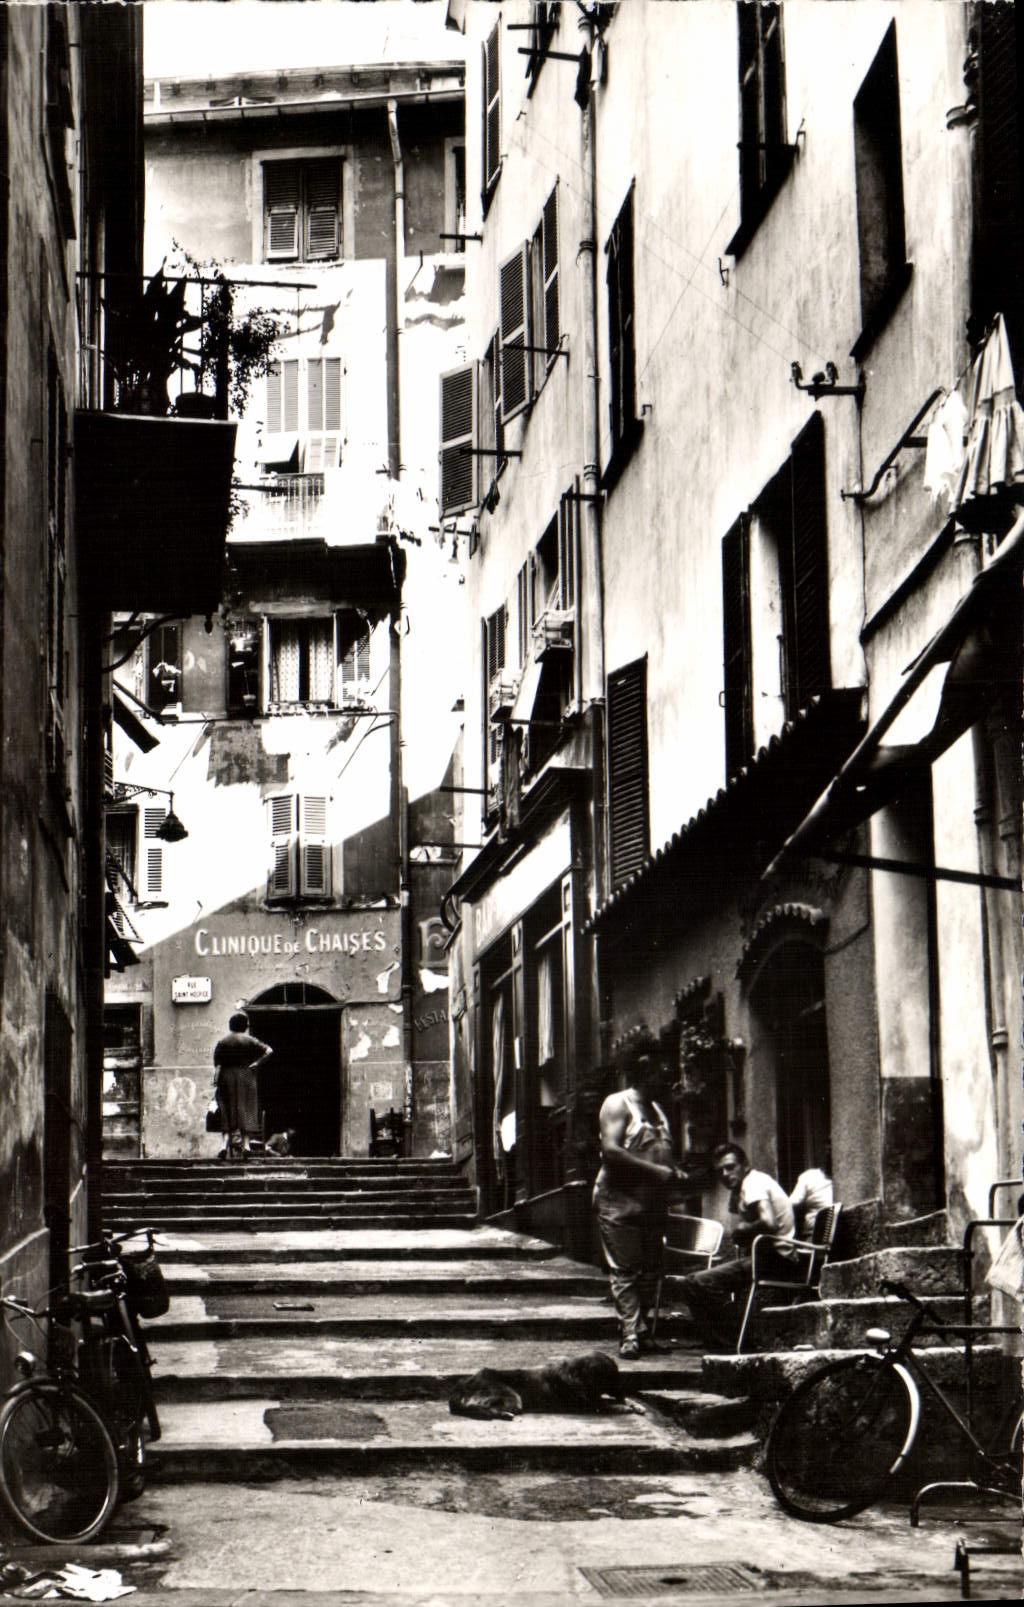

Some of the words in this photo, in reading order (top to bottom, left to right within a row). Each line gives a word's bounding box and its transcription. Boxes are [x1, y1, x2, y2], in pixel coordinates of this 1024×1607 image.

[195, 929, 283, 957] CLINIQUE
[305, 928, 387, 954] CHAISES
[187, 981, 197, 989] RUE
